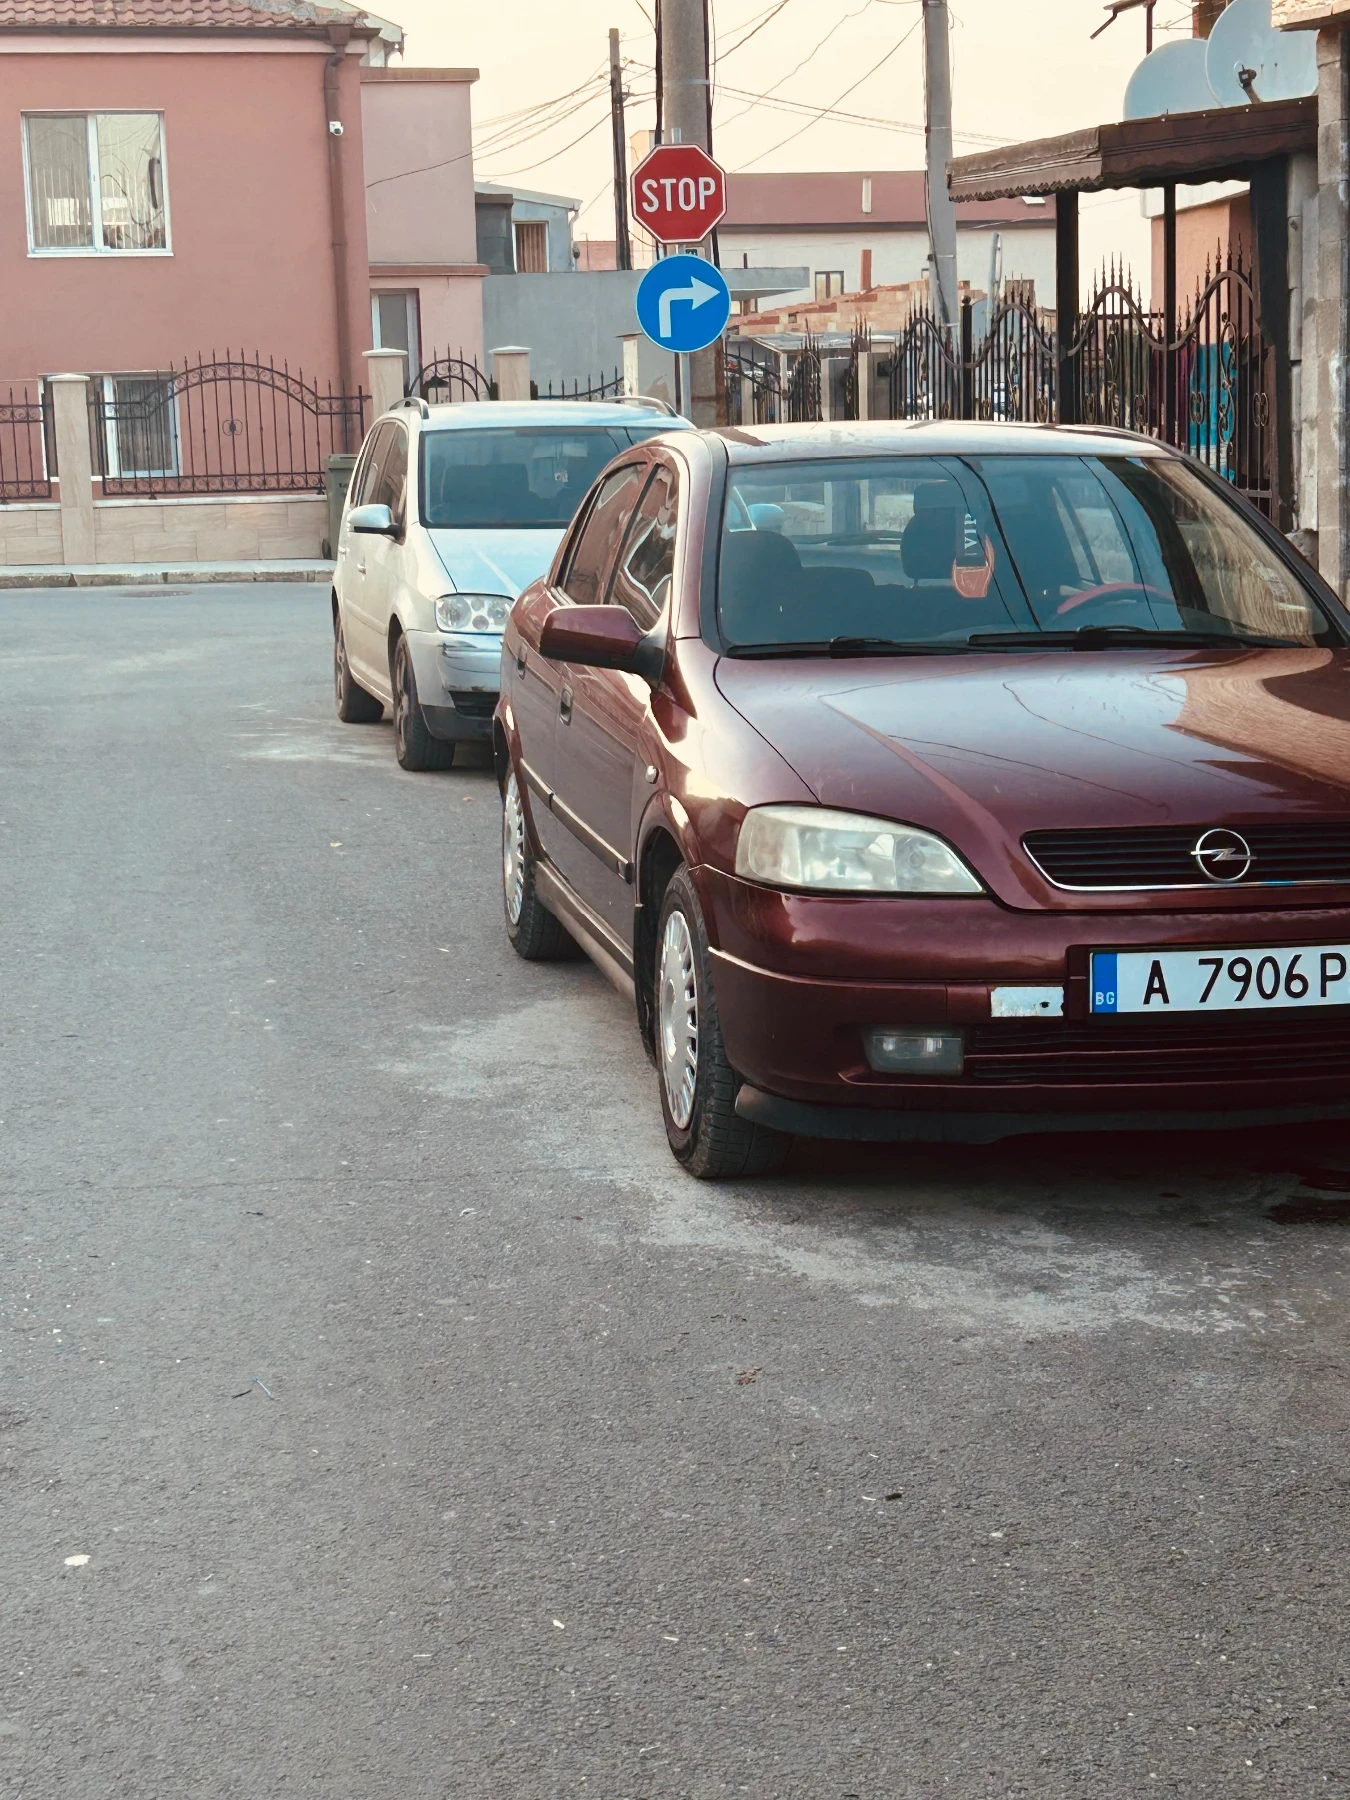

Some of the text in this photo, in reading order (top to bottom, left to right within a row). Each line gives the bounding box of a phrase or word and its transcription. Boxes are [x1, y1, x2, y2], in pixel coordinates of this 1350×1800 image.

[641, 177, 716, 213] STOP
[1095, 991, 1115, 1006] BG
[1143, 959, 1170, 1005] A
